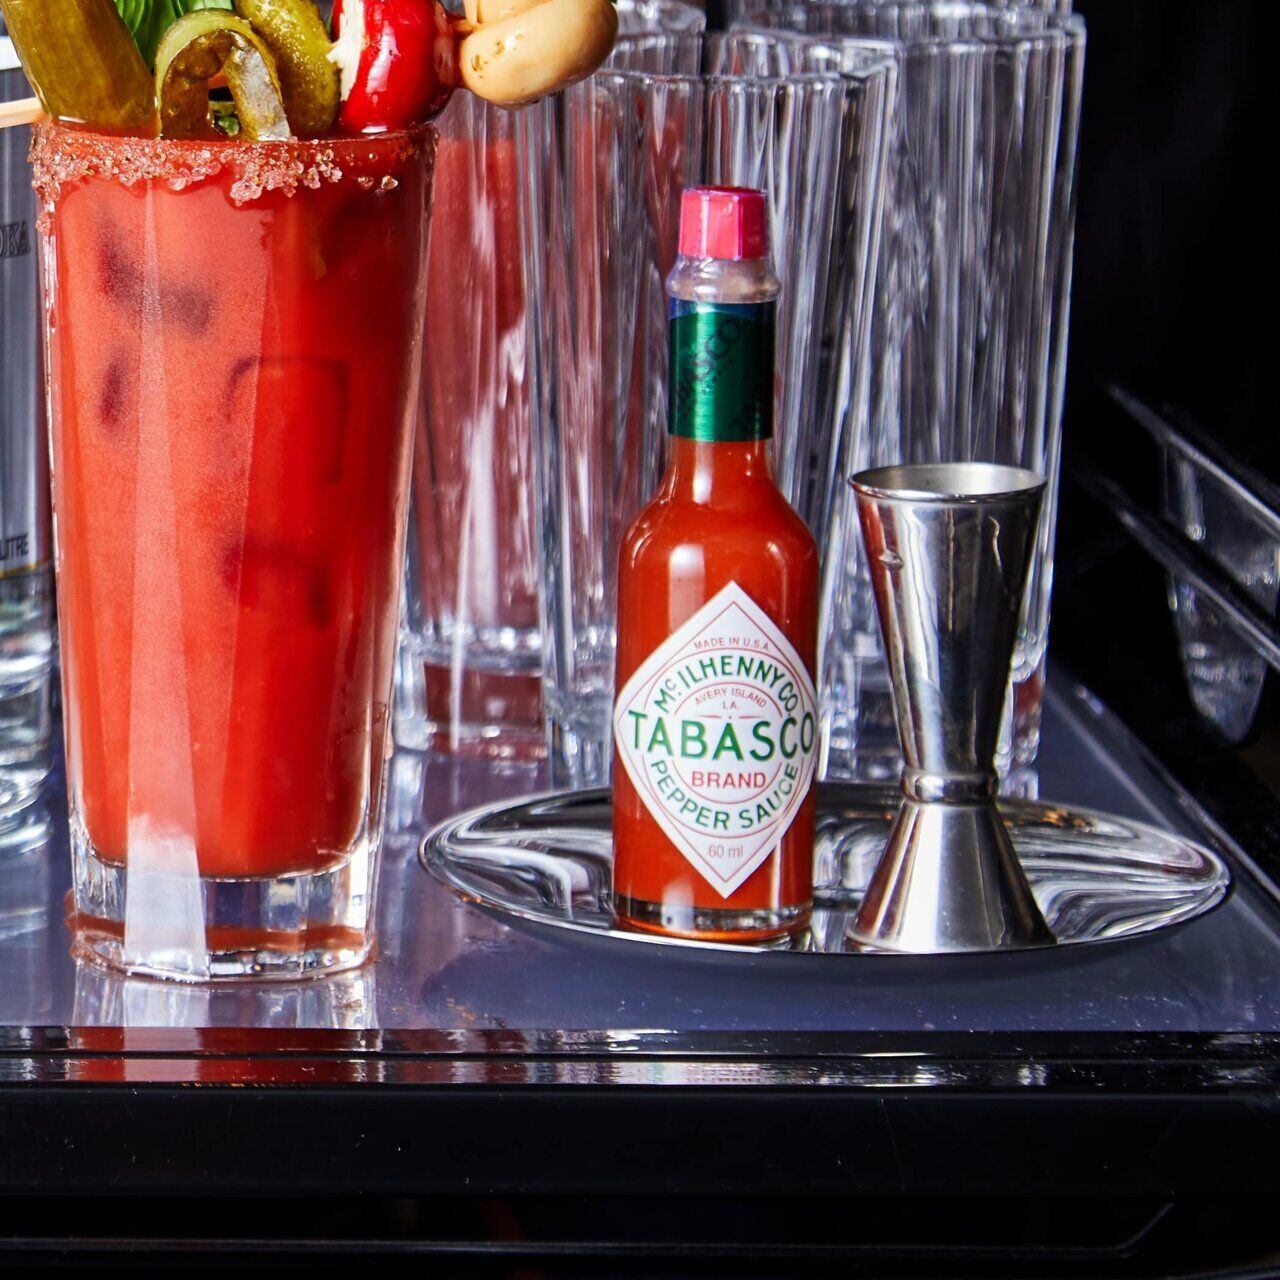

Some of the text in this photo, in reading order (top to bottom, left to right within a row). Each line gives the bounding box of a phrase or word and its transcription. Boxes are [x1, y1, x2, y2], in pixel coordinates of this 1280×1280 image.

[694, 638, 726, 650] MADE
[728, 637, 740, 647] IN
[694, 687, 768, 708] AVERY ISLAND
[628, 711, 814, 763] TABASCO
[691, 771, 767, 789] BRAND
[651, 759, 798, 830] PEPPER SAUCE
[708, 844, 744, 858] 60 ml
